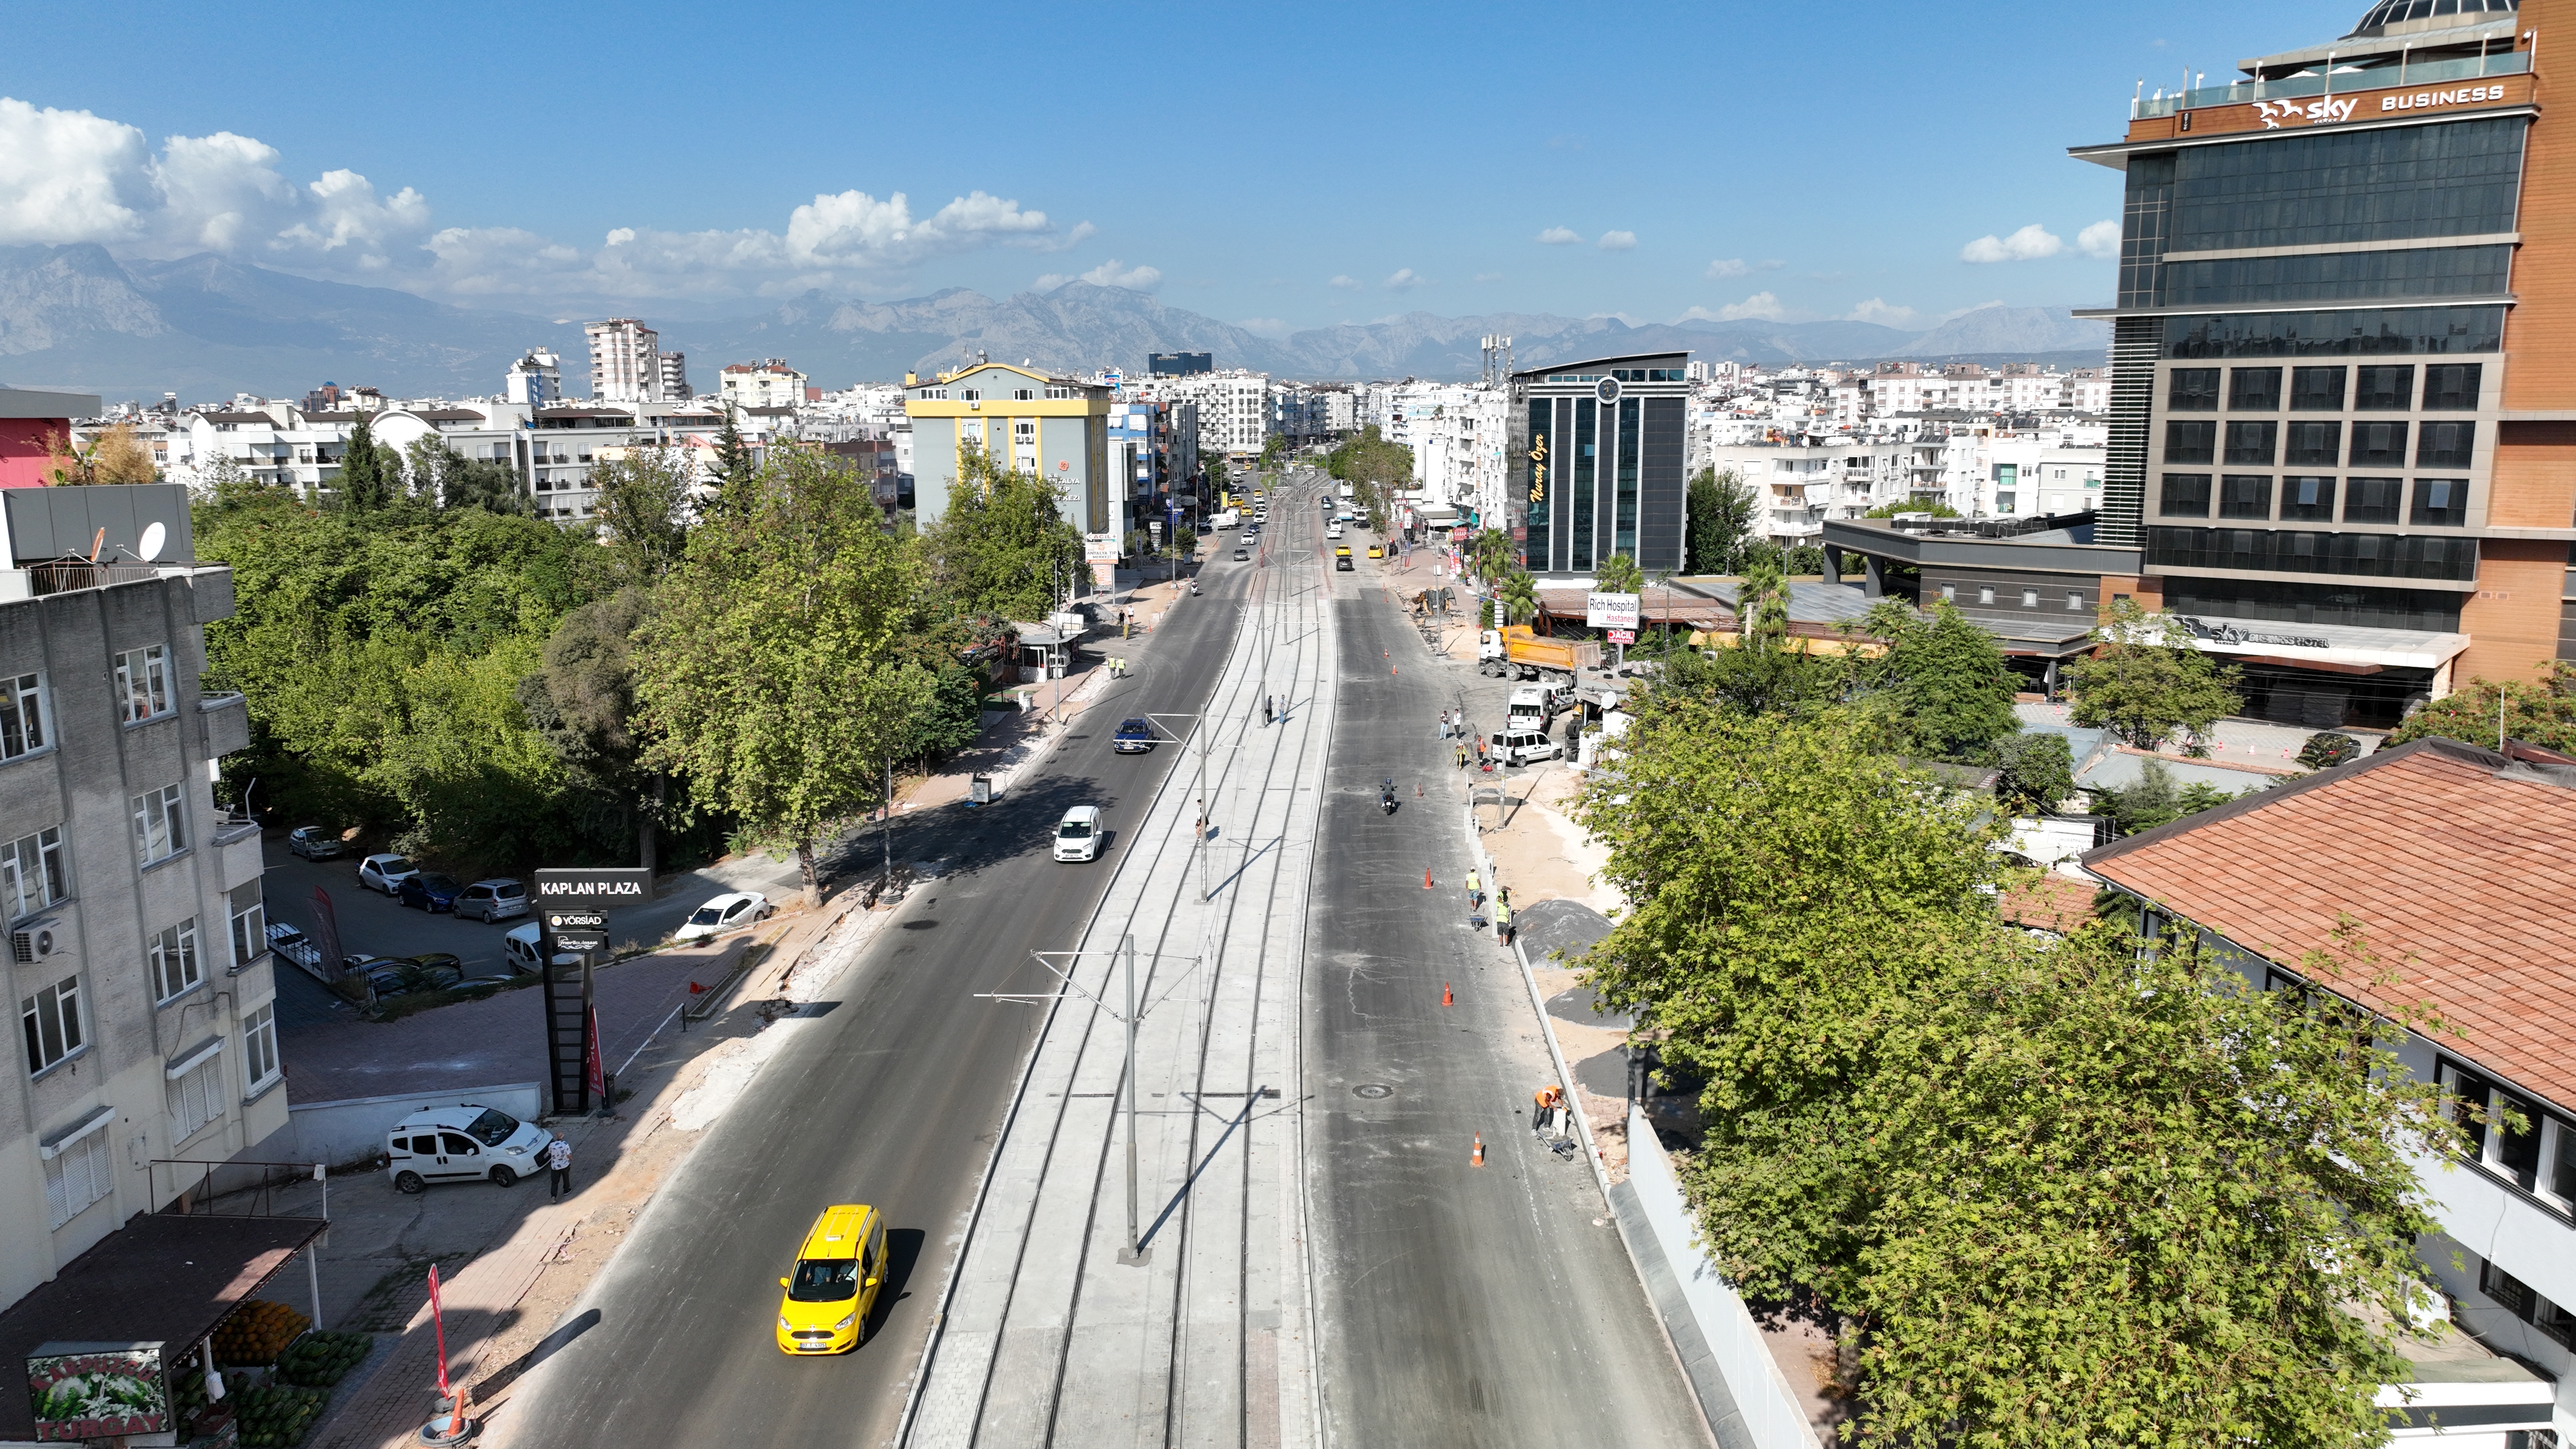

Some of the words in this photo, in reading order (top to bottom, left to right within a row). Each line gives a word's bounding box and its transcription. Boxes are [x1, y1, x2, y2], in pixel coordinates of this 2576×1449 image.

[2307, 95, 2358, 121] sky
[2381, 85, 2504, 111] BUSINESS
[1528, 433, 1548, 461] Özer
[1530, 463, 1547, 503] Nuray
[1590, 598, 1605, 611] Rich
[1607, 599, 1636, 614] Hospital
[1607, 614, 1636, 623] Hastanesi
[2210, 623, 2248, 645] sky
[2249, 633, 2294, 644] BUSINESS
[2296, 637, 2330, 648] HOTEL
[541, 882, 594, 895] KAPLAN
[598, 882, 642, 895] PLAZA
[563, 915, 602, 925] YÖRSİAD
[29, 1357, 157, 1390] KARPUZCU
[35, 1414, 162, 1441] TURGAY
